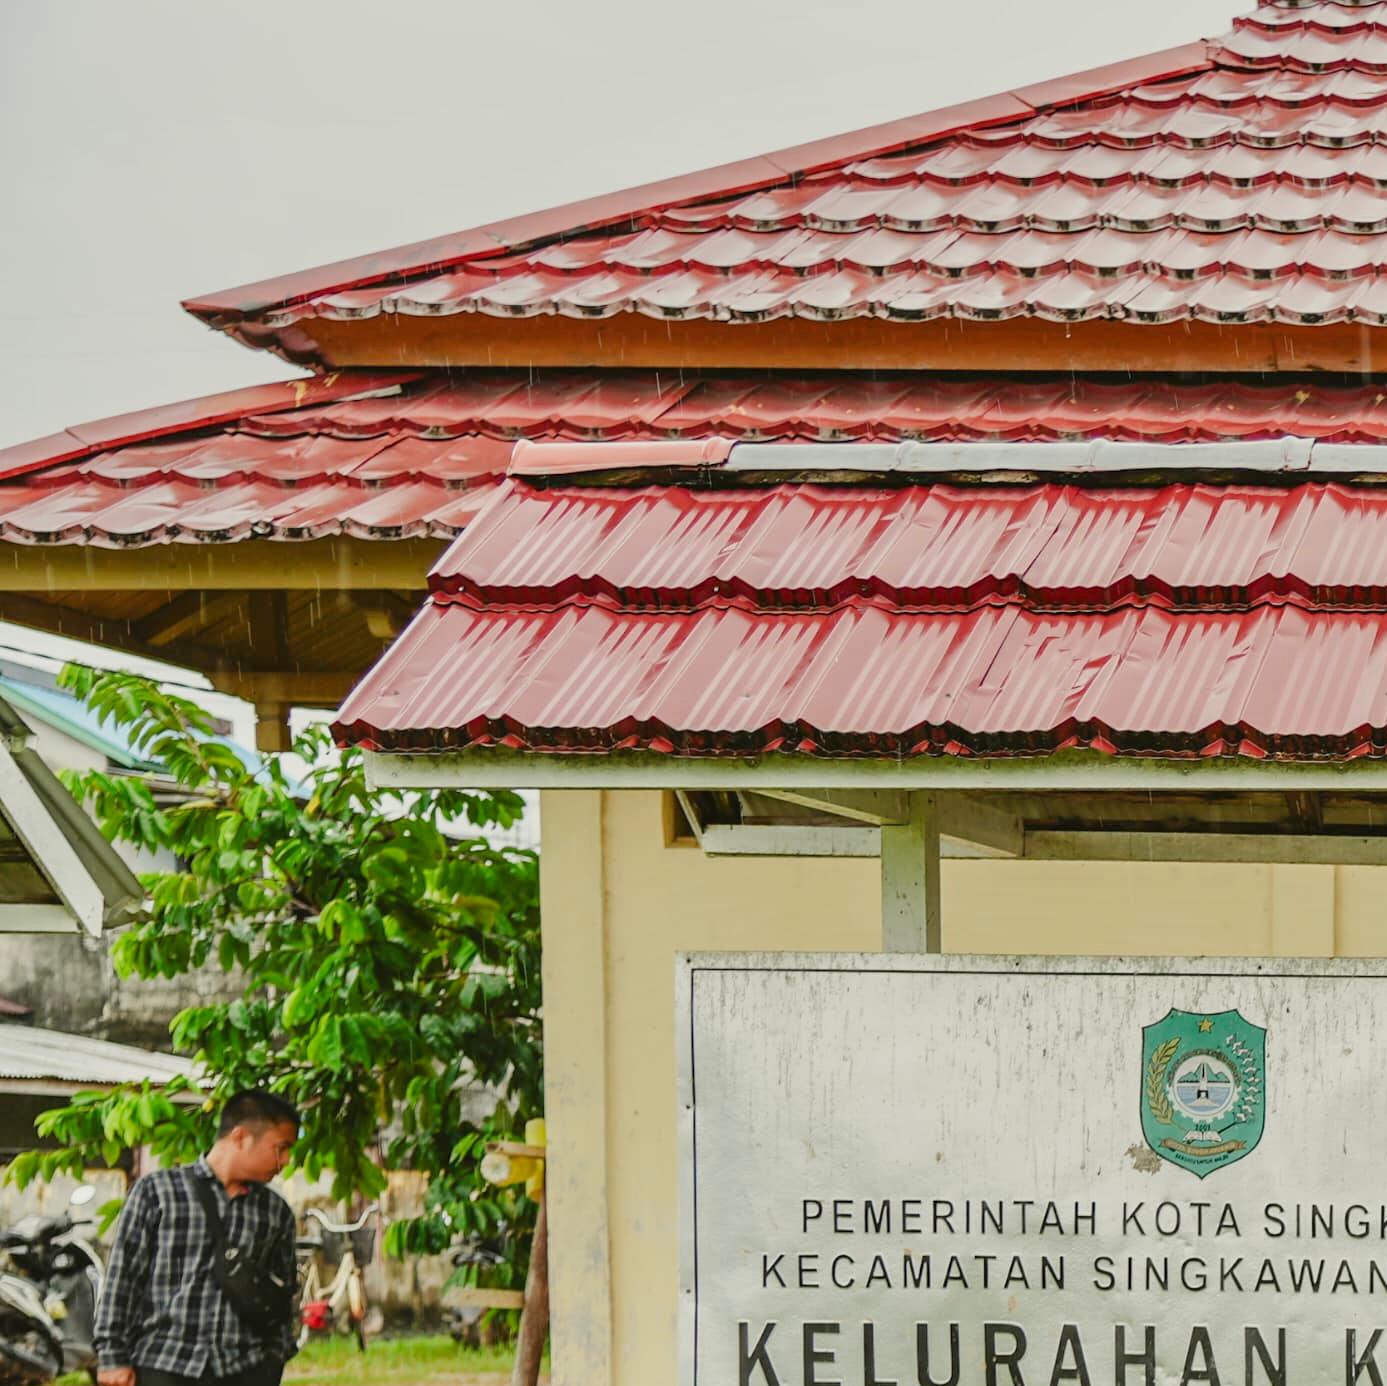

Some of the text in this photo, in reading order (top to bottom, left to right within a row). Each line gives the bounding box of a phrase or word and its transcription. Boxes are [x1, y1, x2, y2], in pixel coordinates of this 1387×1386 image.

[802, 1199, 1097, 1236] PEMERINTAH
[1122, 1201, 1242, 1238] KOTA
[762, 1253, 1065, 1291] KECAMATAN
